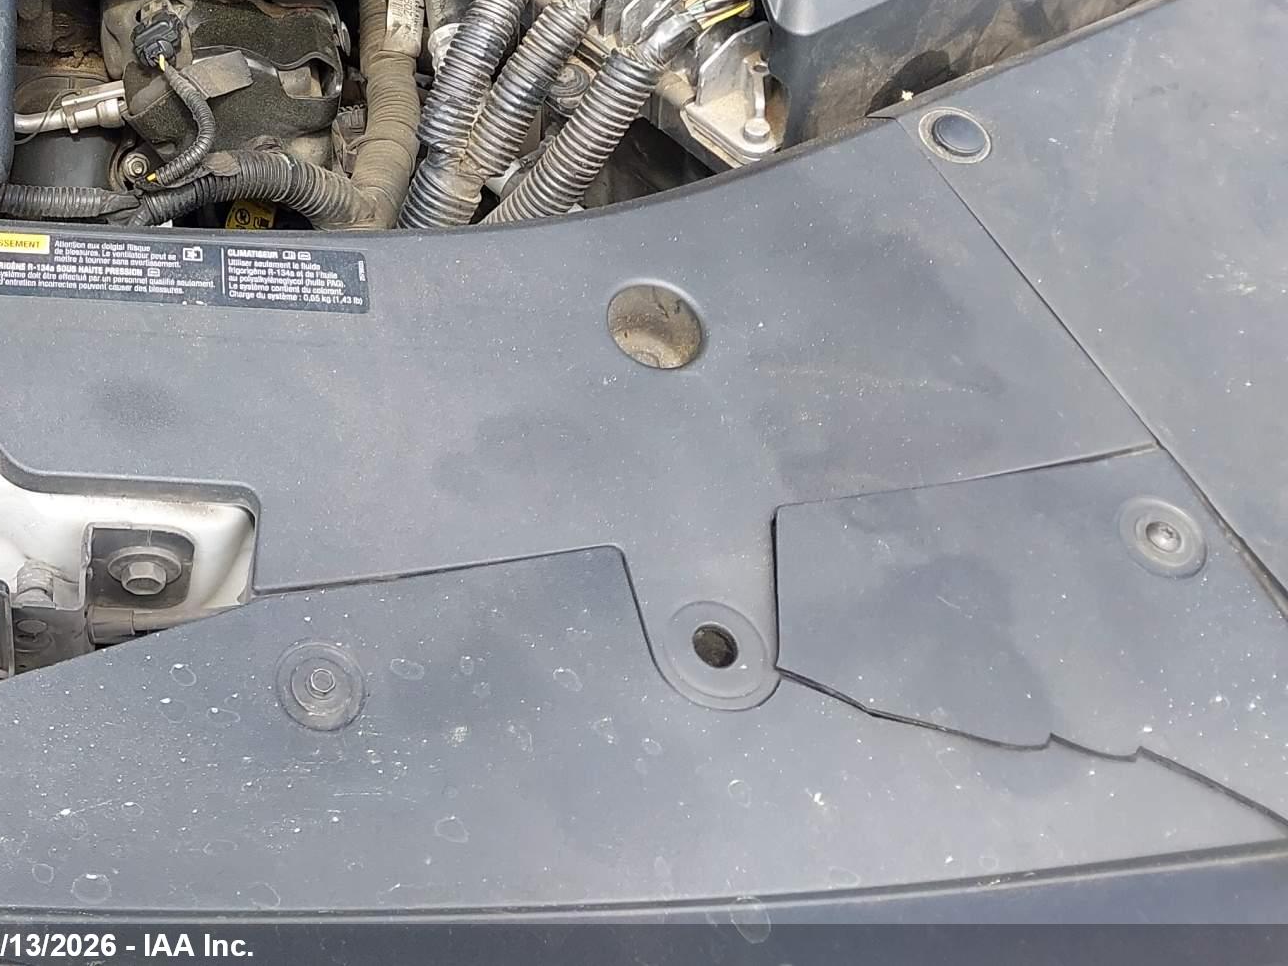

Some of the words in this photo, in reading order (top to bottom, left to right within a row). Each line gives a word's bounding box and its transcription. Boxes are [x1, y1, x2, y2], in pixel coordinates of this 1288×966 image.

[54, 240, 86, 248] Attention
[228, 249, 278, 258] CLIMATISEUR
[228, 258, 252, 266] Utiliser
[254, 260, 291, 268] seulement
[28, 263, 54, 272] R-134a
[56, 264, 76, 273] SOUS
[78, 266, 103, 274] HAUTE
[104, 267, 143, 276] PRESSION
[268, 268, 294, 277] R-134a
[38, 280, 77, 288] incorrectes
[229, 290, 254, 300] Charge
[322, 295, 332, 304] kg
[353, 296, 363, 305] lb)
